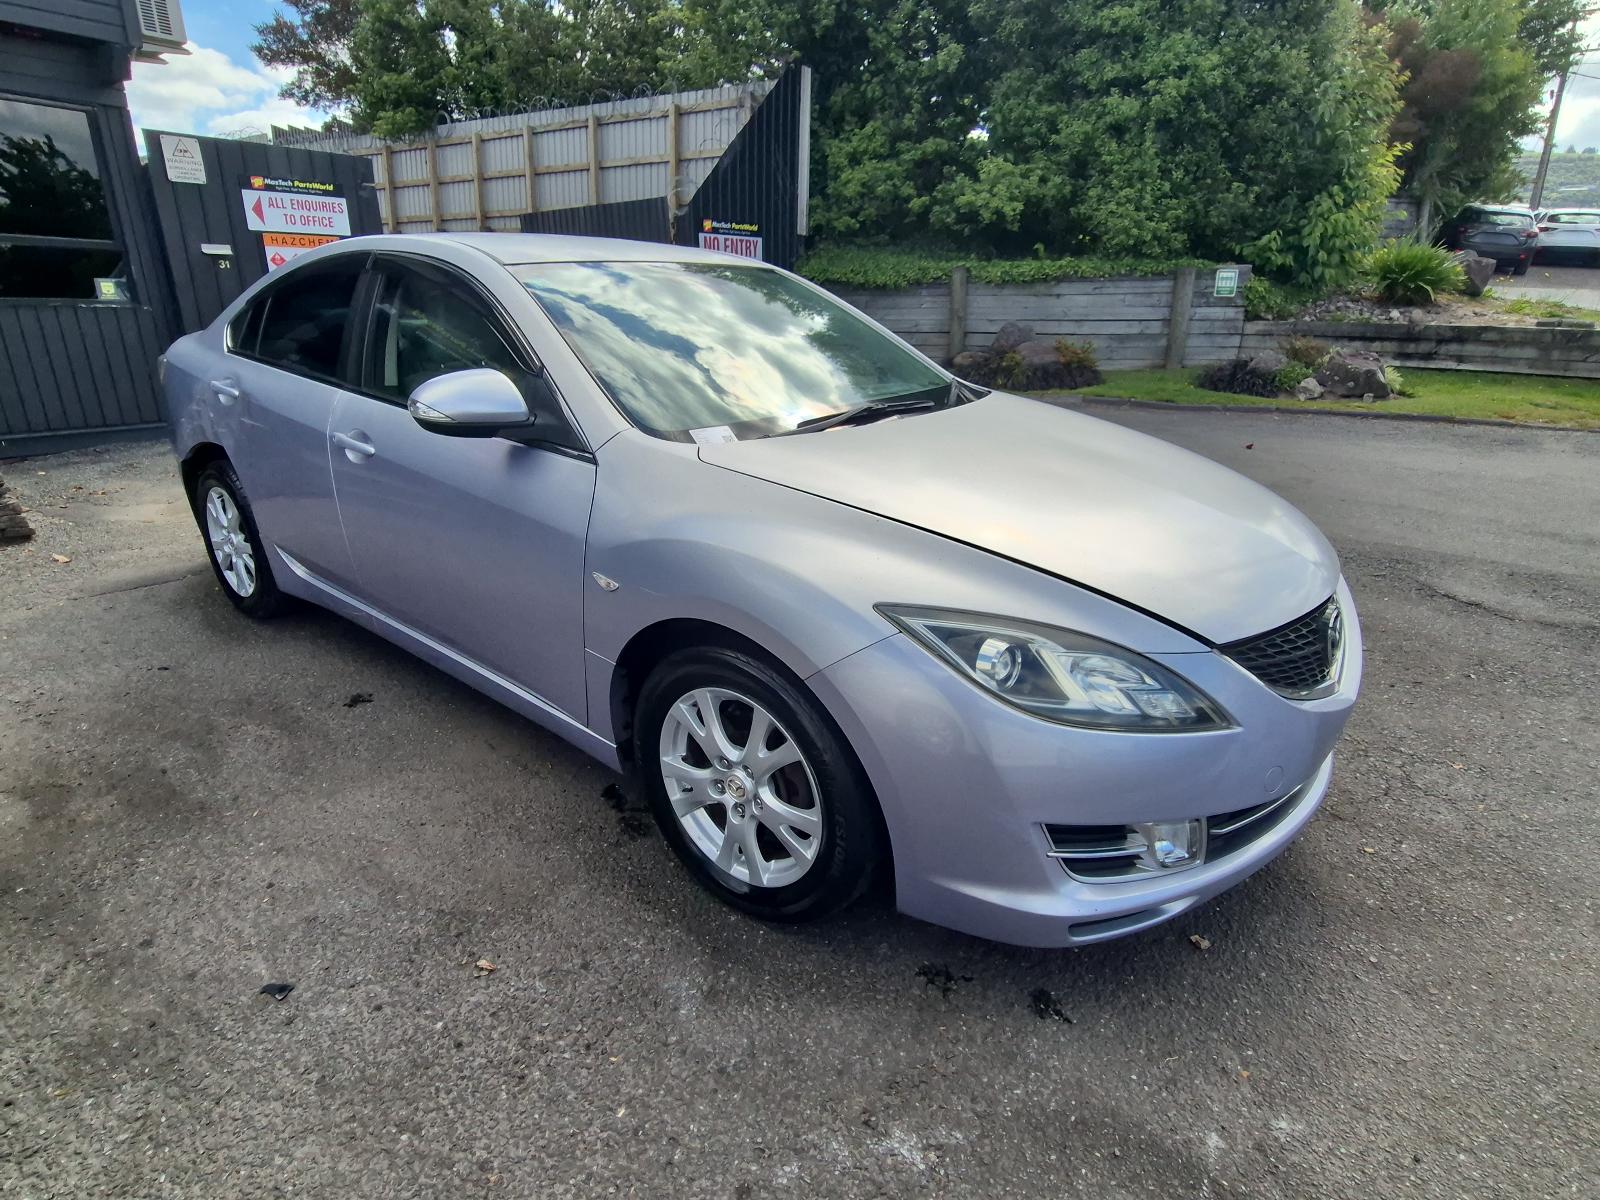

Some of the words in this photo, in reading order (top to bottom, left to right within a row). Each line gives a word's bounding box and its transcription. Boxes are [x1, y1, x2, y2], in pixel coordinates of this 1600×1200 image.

[294, 181, 334, 191] PartsWorld
[268, 197, 287, 209] ALL
[290, 199, 344, 214] ENQUIRIES
[283, 213, 296, 226] TO
[300, 214, 335, 228] OFFICE
[703, 235, 720, 251] NO
[723, 237, 759, 258] ENTRY
[218, 260, 230, 269] 31
